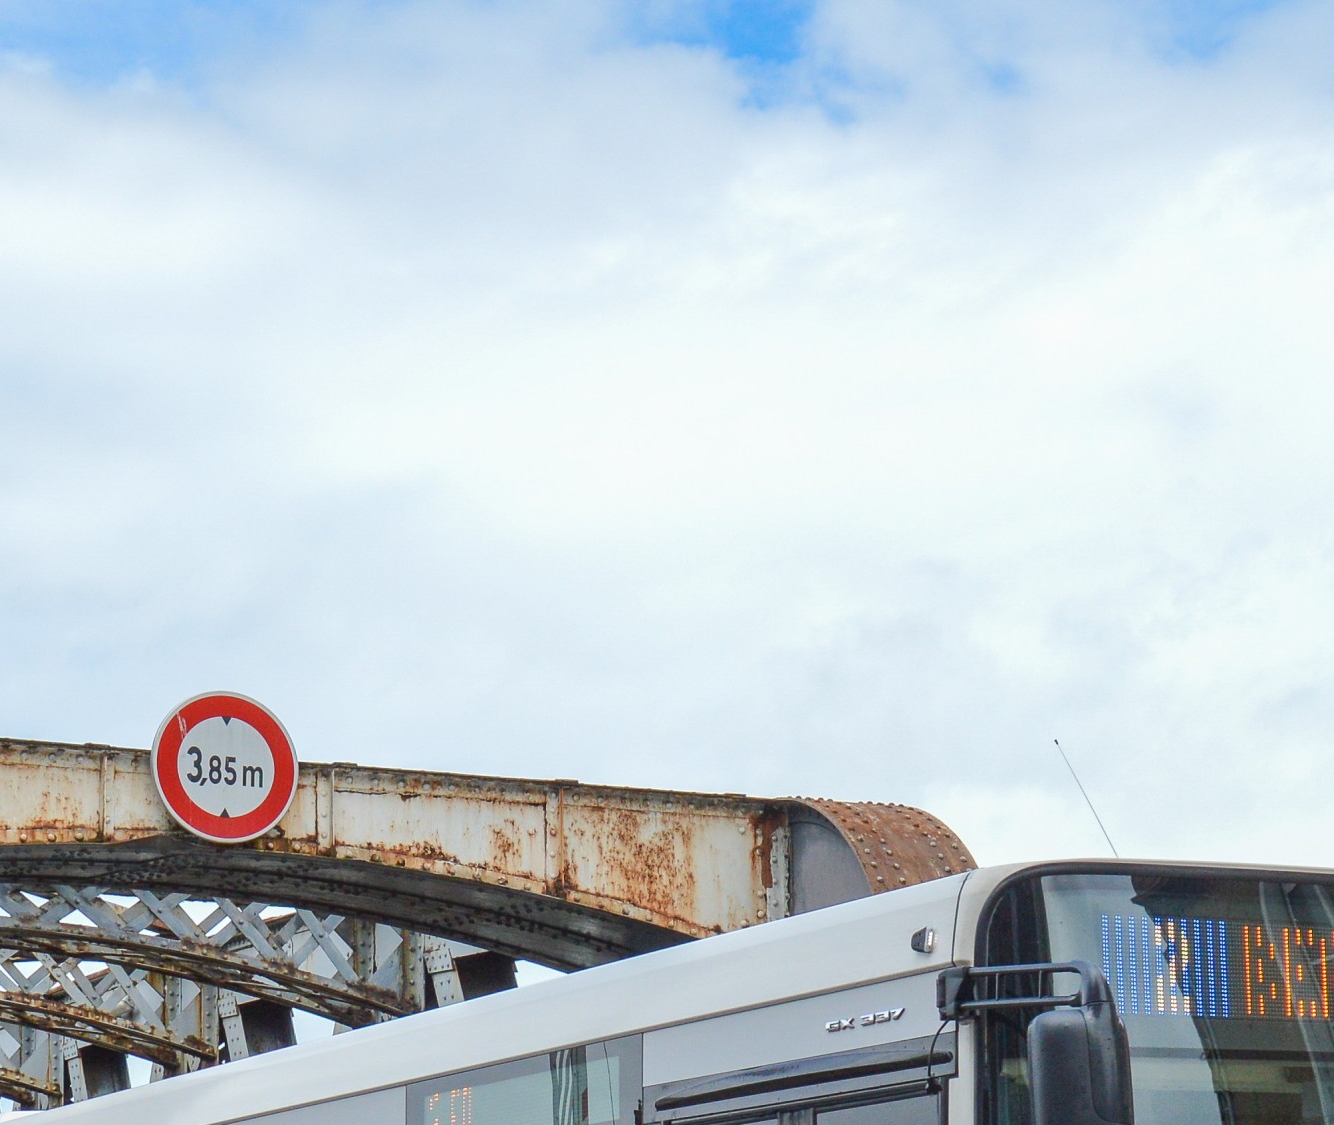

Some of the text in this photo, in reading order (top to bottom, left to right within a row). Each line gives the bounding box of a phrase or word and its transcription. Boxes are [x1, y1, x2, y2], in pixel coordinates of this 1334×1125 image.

[186, 745, 264, 788] 3,85 m
[825, 1007, 905, 1032] GX 337
